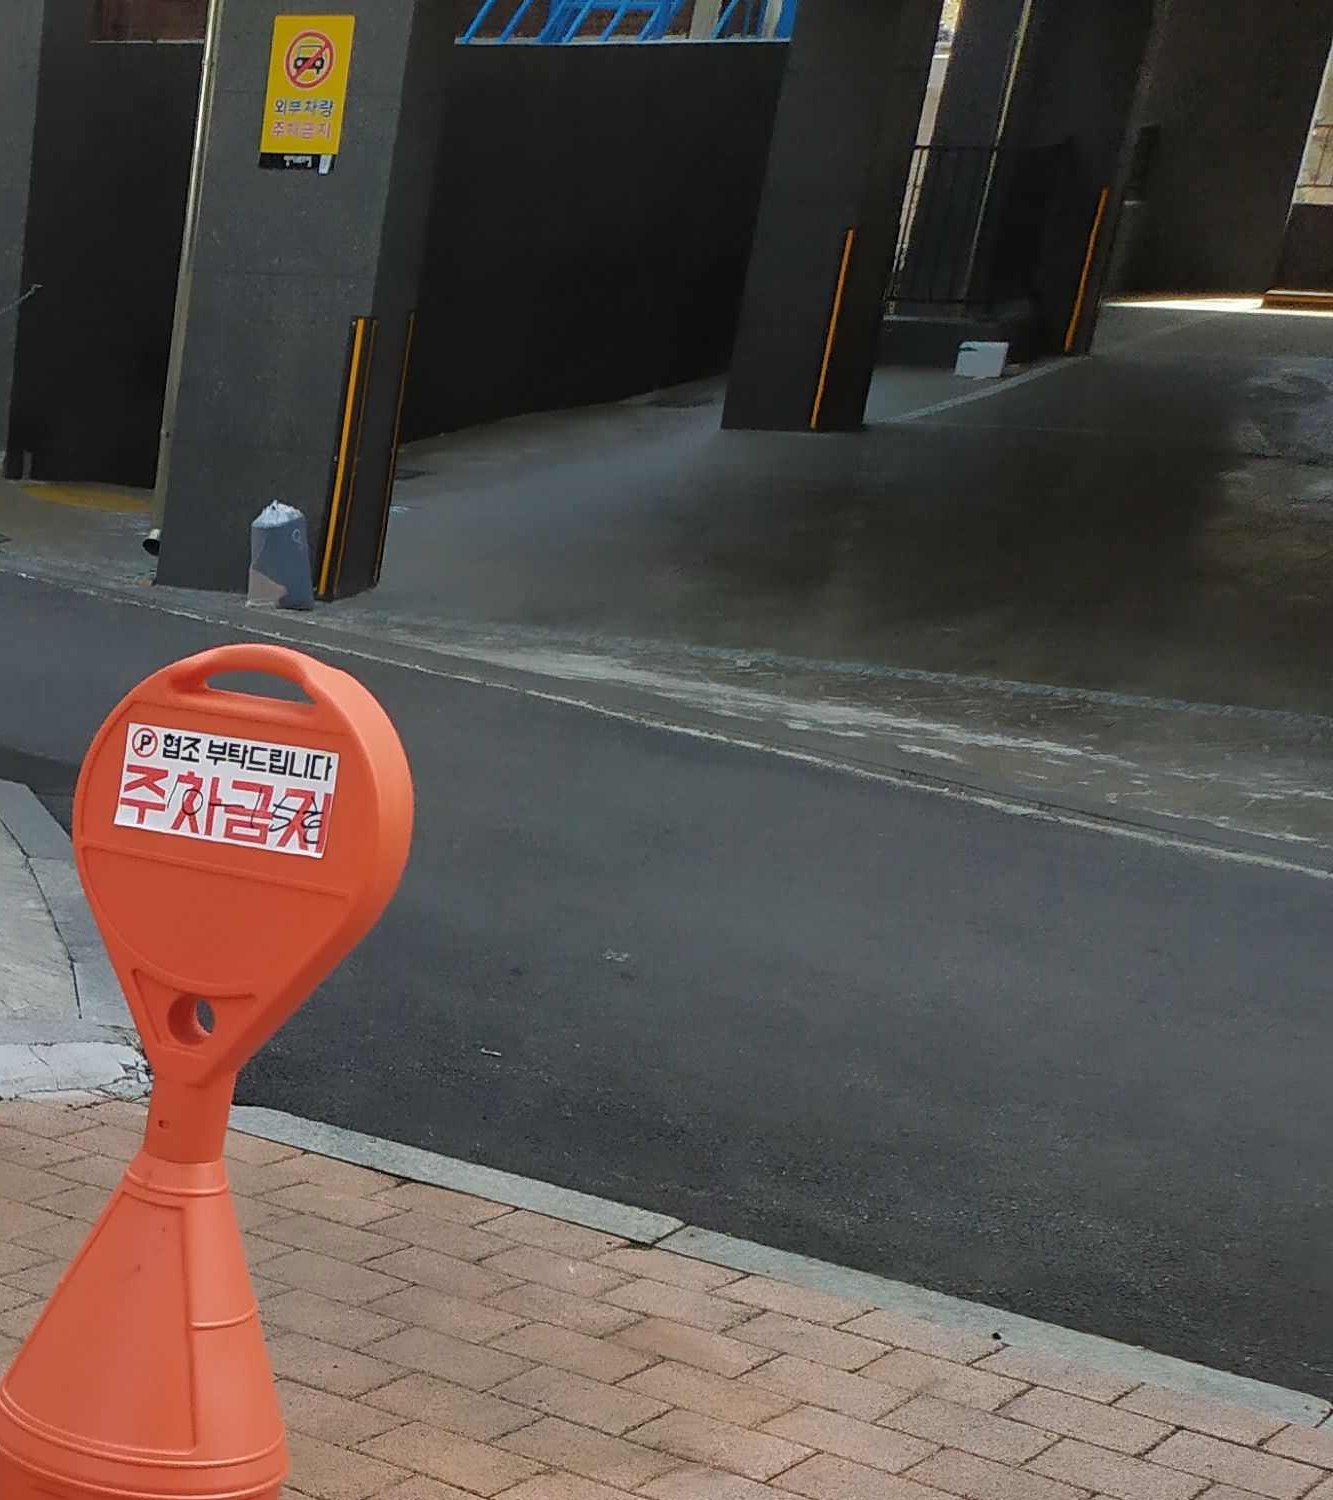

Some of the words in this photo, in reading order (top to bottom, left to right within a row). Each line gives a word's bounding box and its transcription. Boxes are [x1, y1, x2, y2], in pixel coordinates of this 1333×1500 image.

[162, 732, 201, 763] 협조
[206, 739, 332, 781] 부탁드립니다
[119, 763, 332, 854] 주차금지
